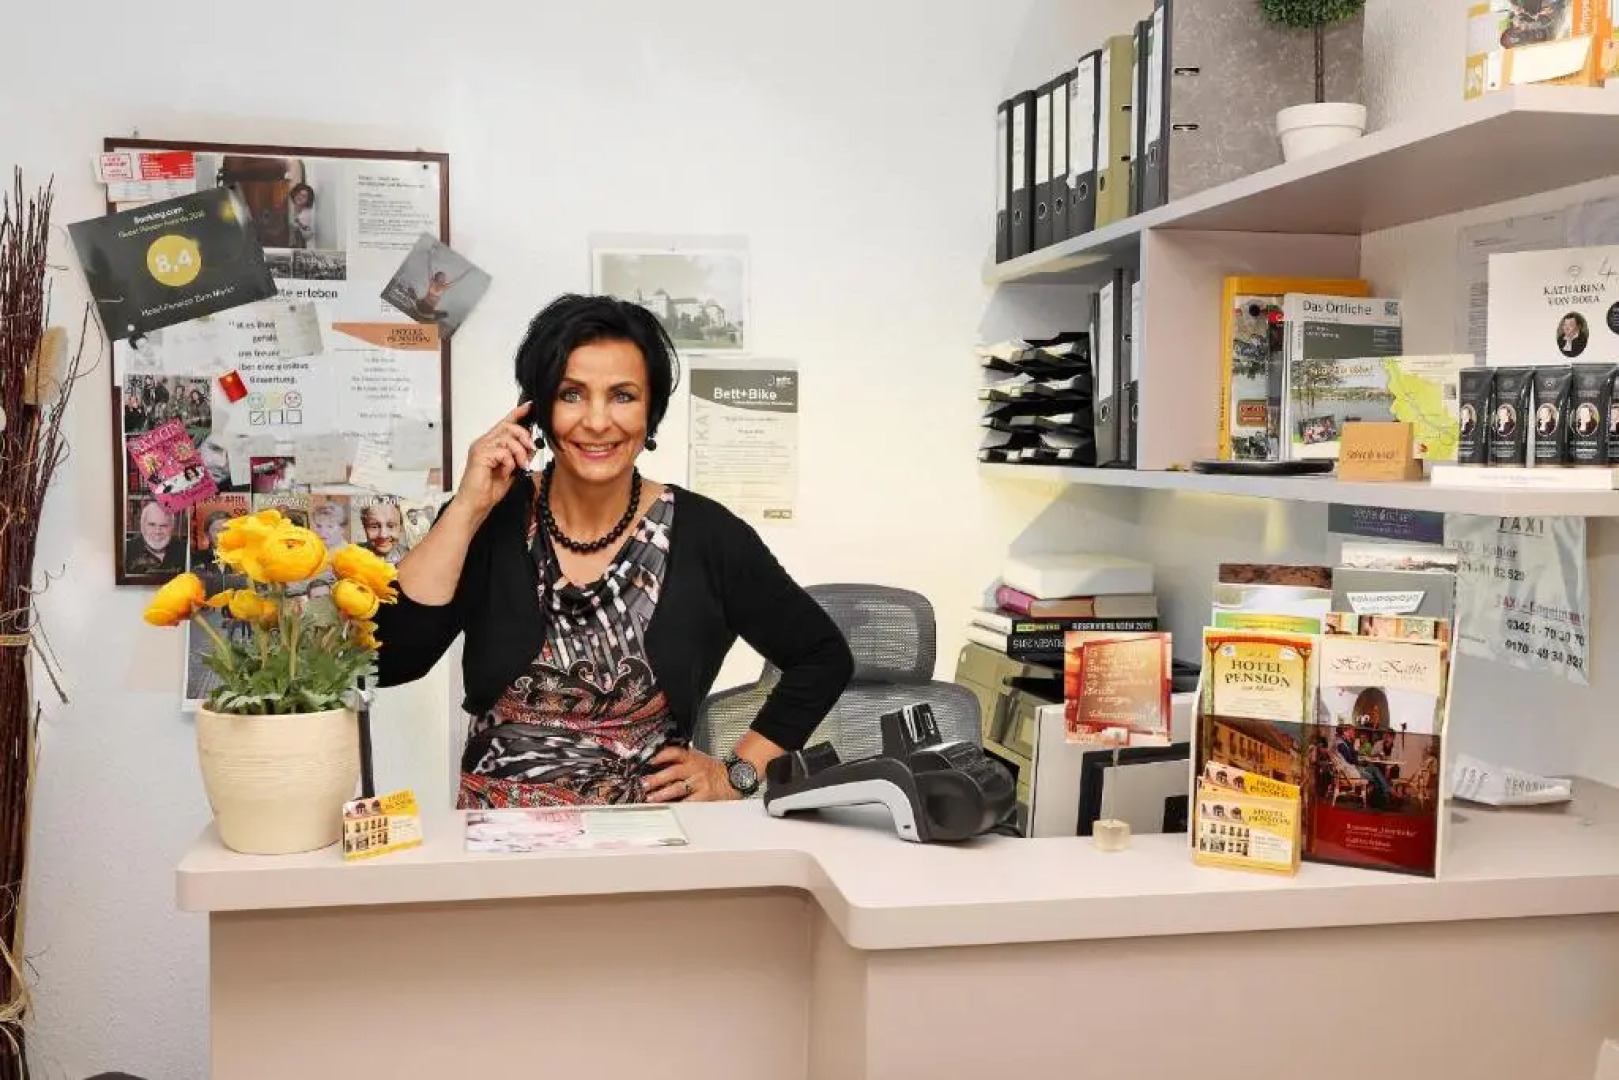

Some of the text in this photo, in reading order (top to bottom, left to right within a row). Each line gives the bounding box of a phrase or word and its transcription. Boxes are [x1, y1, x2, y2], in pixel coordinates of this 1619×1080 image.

[133, 206, 184, 225] Booking.com
[296, 287, 338, 299] erleben
[1544, 282, 1606, 296] KATHARINA
[1303, 300, 1325, 312] Das
[1547, 296, 1570, 306] VON
[713, 387, 777, 401] Bett+Bike
[1498, 516, 1544, 533] TAXI
[1230, 659, 1284, 673] HOTEL
[1224, 672, 1292, 688] PENSION
